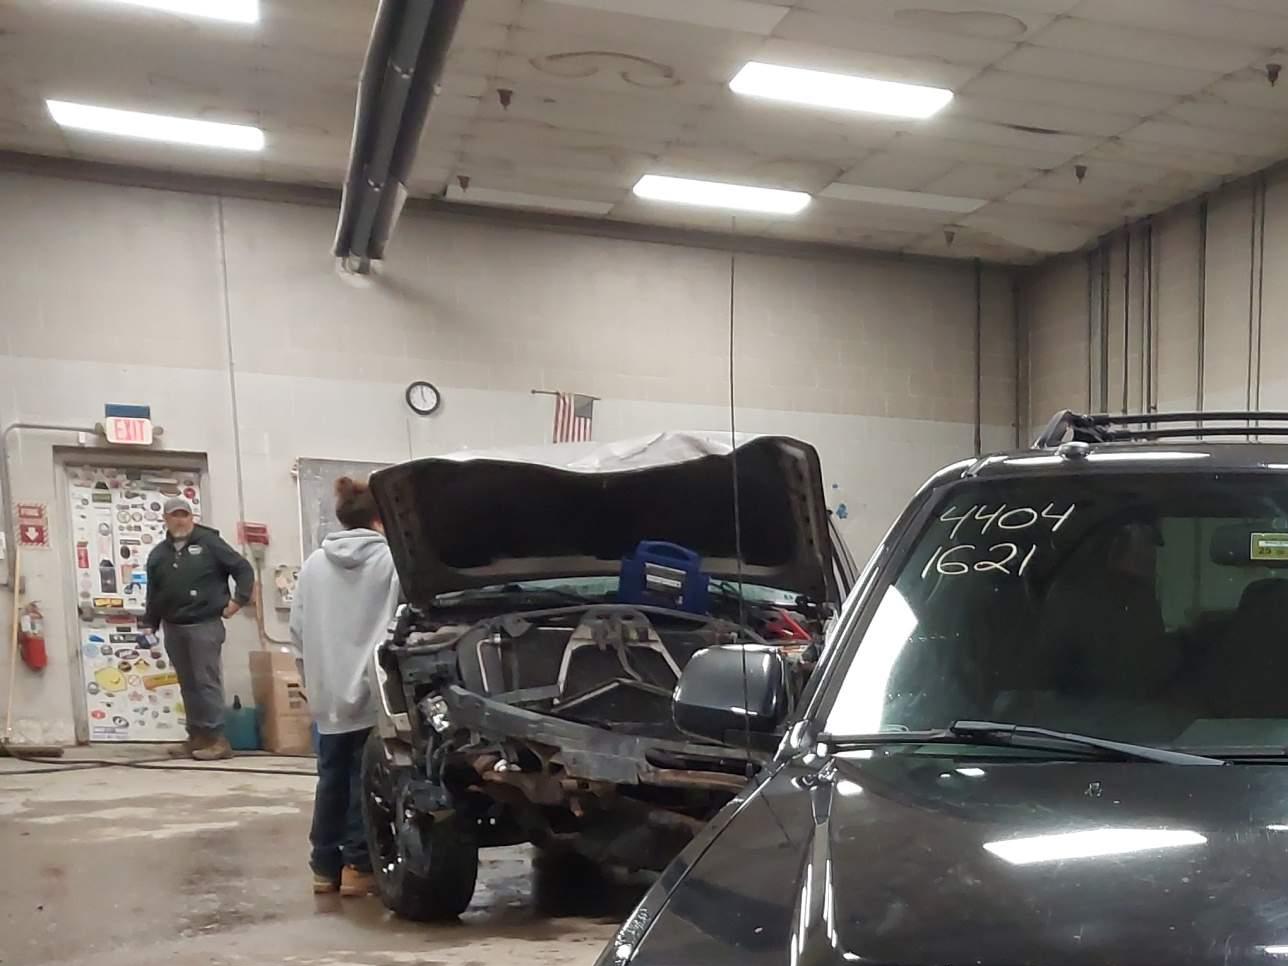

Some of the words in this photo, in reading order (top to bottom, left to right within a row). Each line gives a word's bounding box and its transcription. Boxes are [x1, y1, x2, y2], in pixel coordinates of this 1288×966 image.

[114, 419, 145, 441] EXIT
[939, 503, 1076, 540] 4404
[921, 543, 1037, 580] 1621
